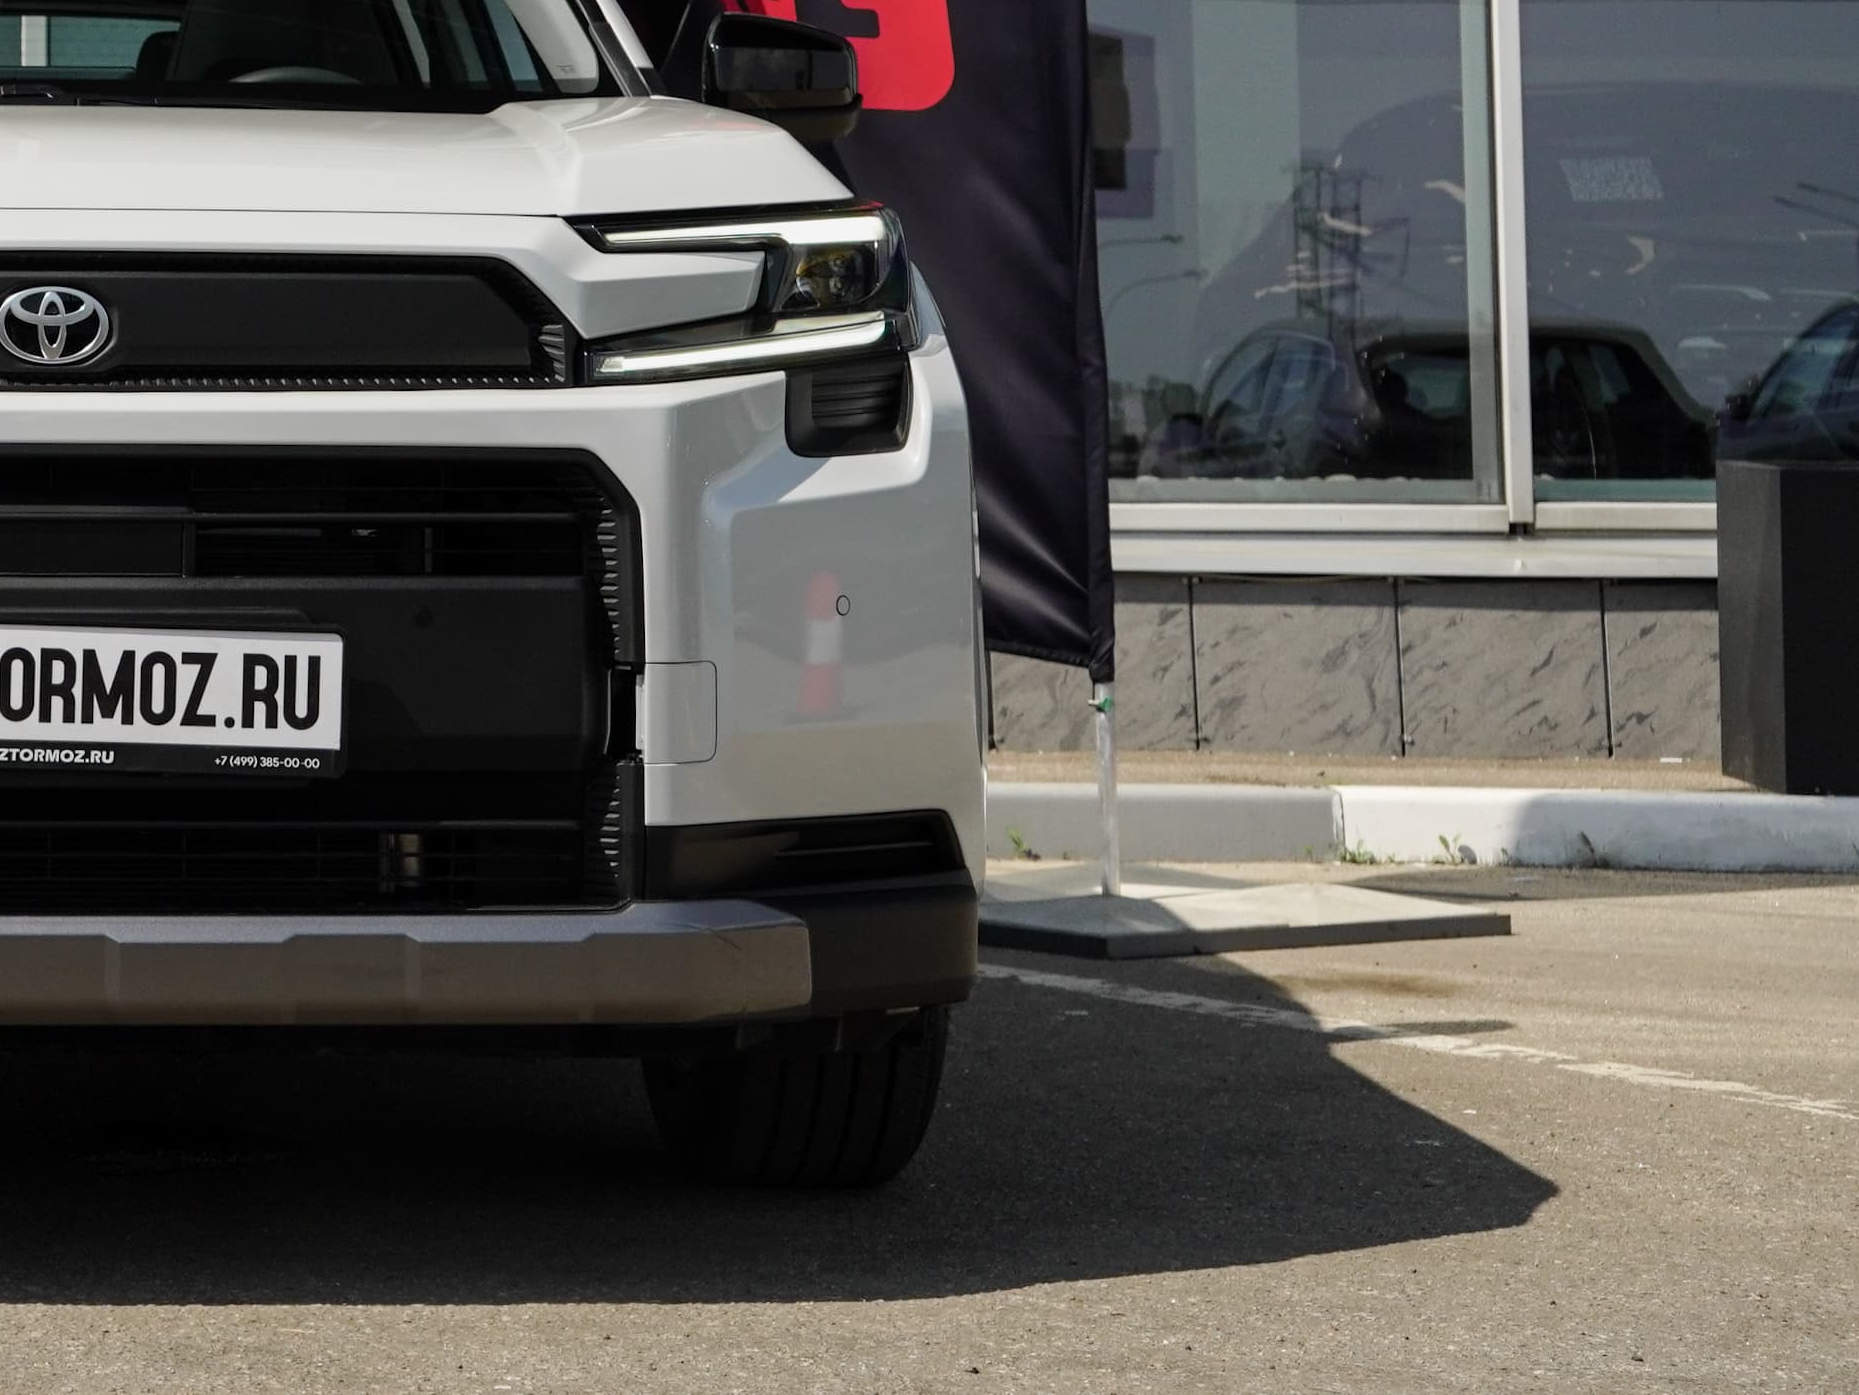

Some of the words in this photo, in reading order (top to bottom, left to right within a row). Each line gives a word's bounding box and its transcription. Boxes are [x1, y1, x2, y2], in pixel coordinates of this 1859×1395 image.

[214, 755, 228, 766] +7
[229, 755, 258, 768] (499)
[259, 756, 320, 769] 385-00-00
